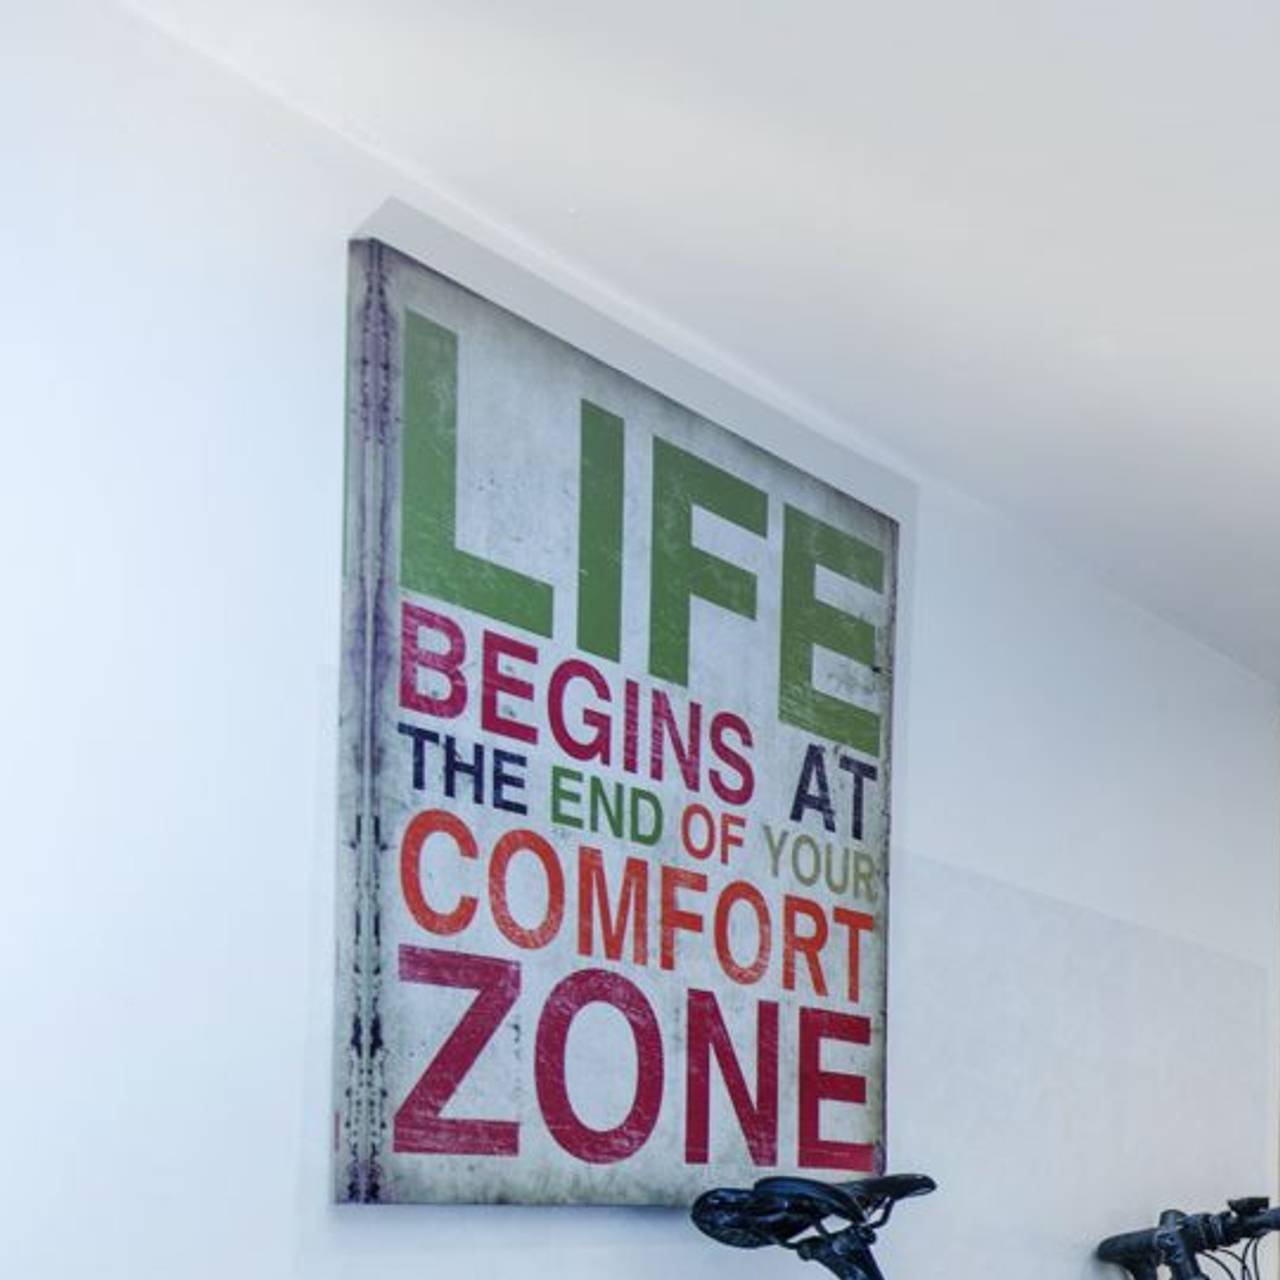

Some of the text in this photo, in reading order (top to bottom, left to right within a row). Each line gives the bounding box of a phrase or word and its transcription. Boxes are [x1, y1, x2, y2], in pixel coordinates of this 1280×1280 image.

[400, 307, 884, 757] LIFE
[397, 723, 878, 901] THE END OF YOUR
[399, 601, 878, 841] BEGINS AT
[400, 809, 875, 1004] COMFORT
[393, 944, 875, 1172] ZONE
